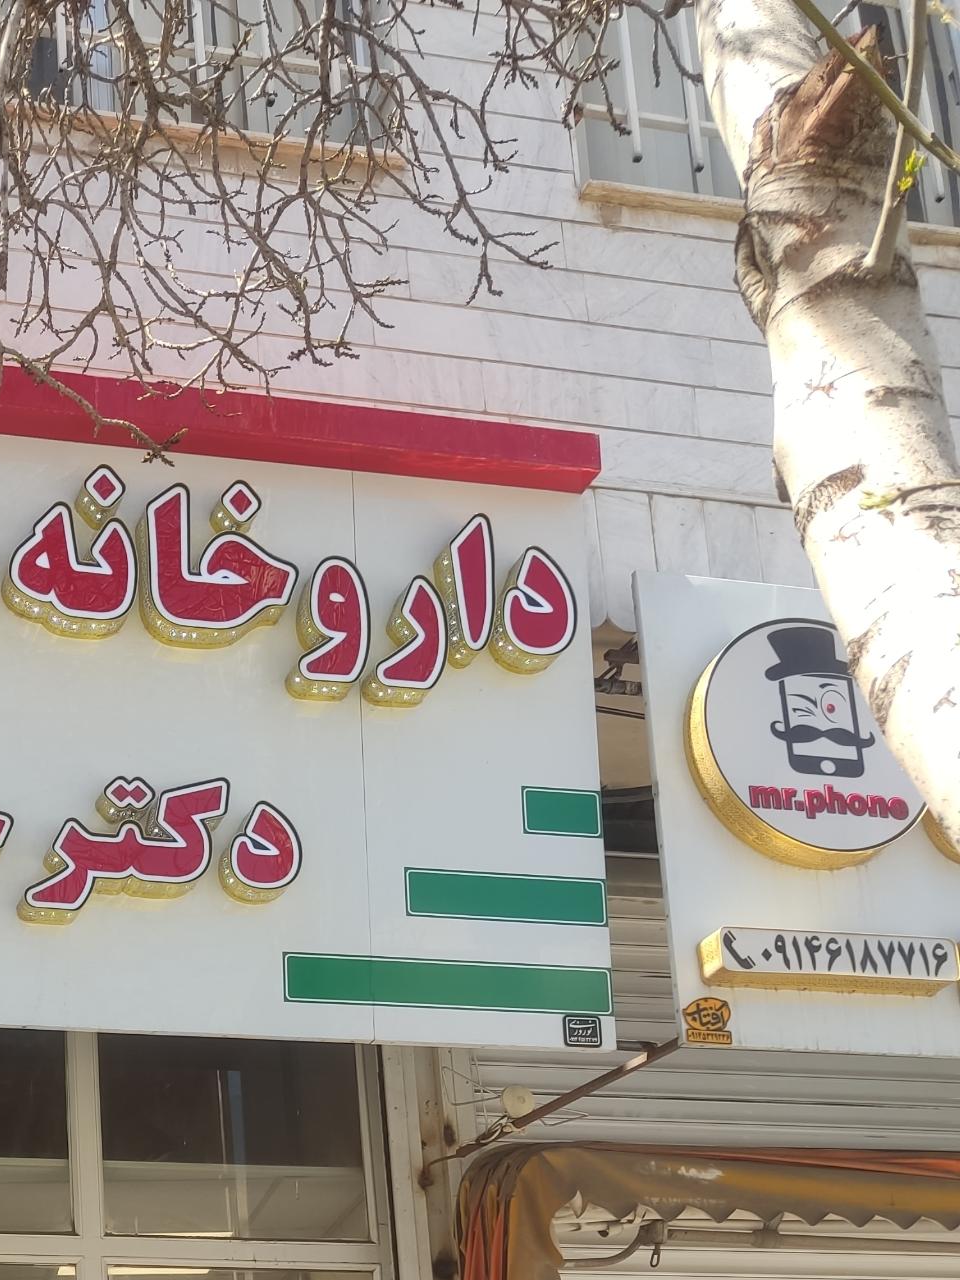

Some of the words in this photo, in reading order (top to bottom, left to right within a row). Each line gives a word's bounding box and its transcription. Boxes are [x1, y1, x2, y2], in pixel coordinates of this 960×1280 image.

[6, 464, 579, 694] داروخانه
[22, 775, 303, 914] دکتر
[748, 784, 909, 820] mr.phone
[760, 933, 948, 977] ۰۹۱۴۶۱۸۷۷۱۶
